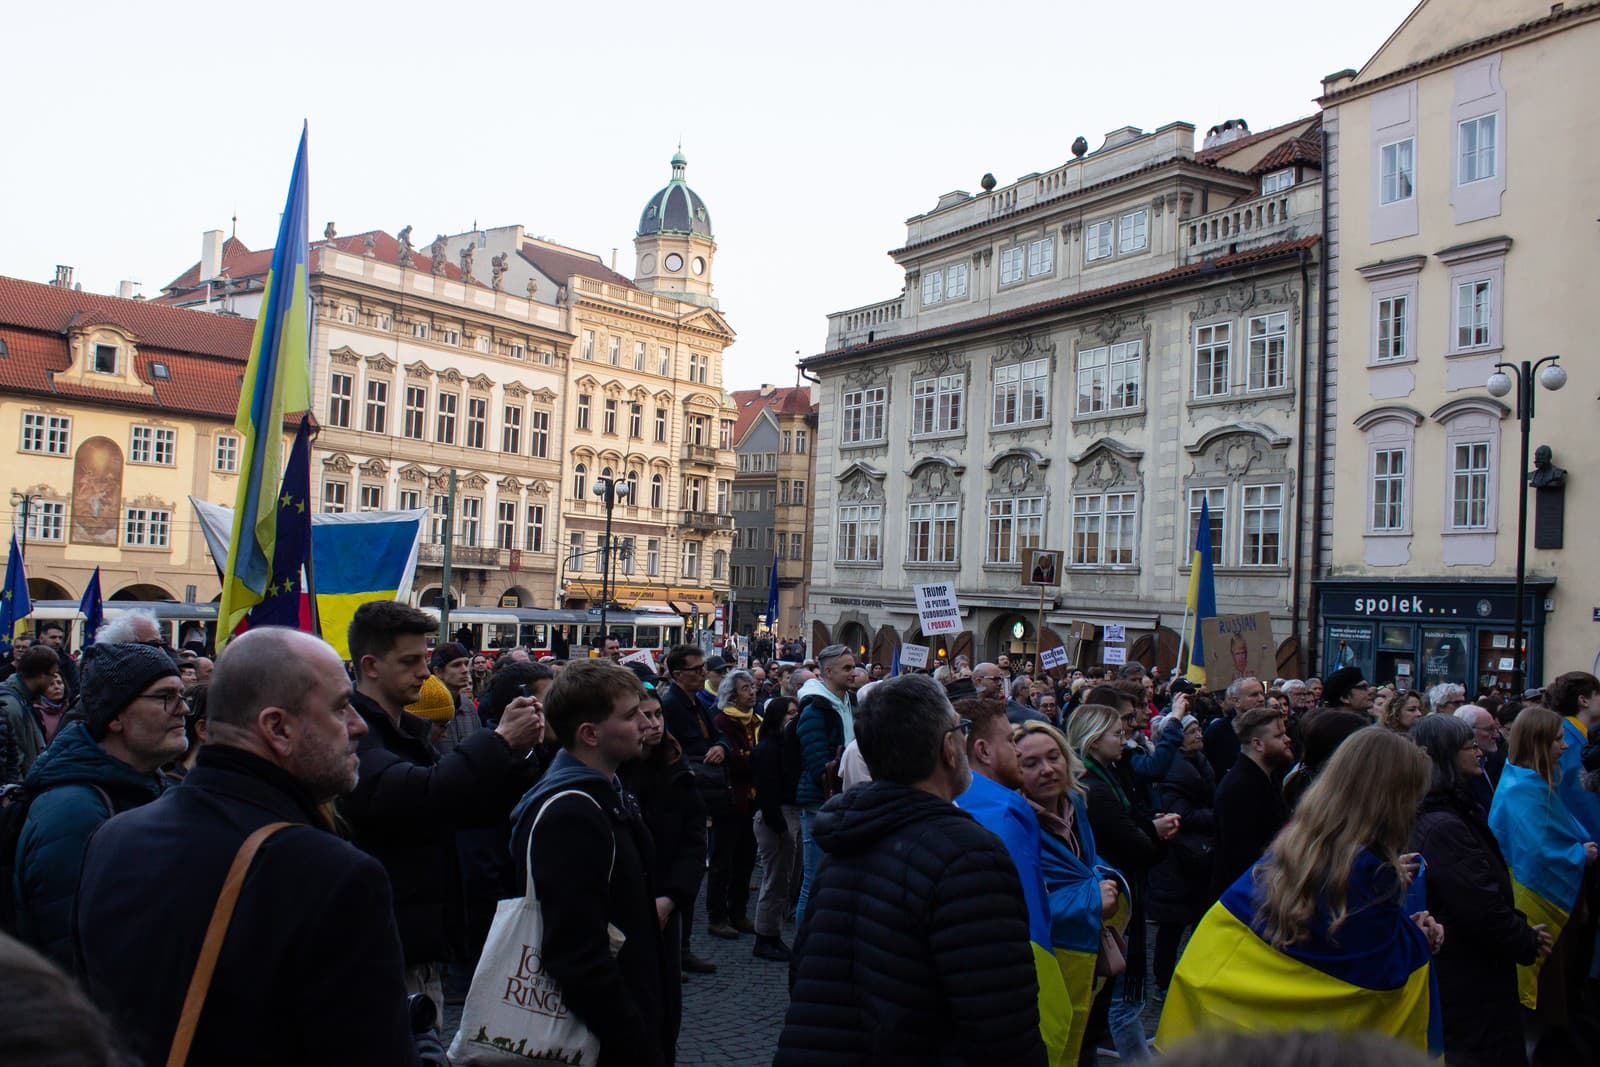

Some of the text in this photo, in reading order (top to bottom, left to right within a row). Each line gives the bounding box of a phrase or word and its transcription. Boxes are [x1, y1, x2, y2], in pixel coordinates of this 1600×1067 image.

[922, 586, 947, 598] TRUMP
[862, 600, 882, 608] COFFEE
[932, 599, 950, 608] PUTINS
[922, 608, 958, 619] SUBORDINATE
[1219, 614, 1257, 634] RUSSIAN
[530, 976, 544, 986] OF
